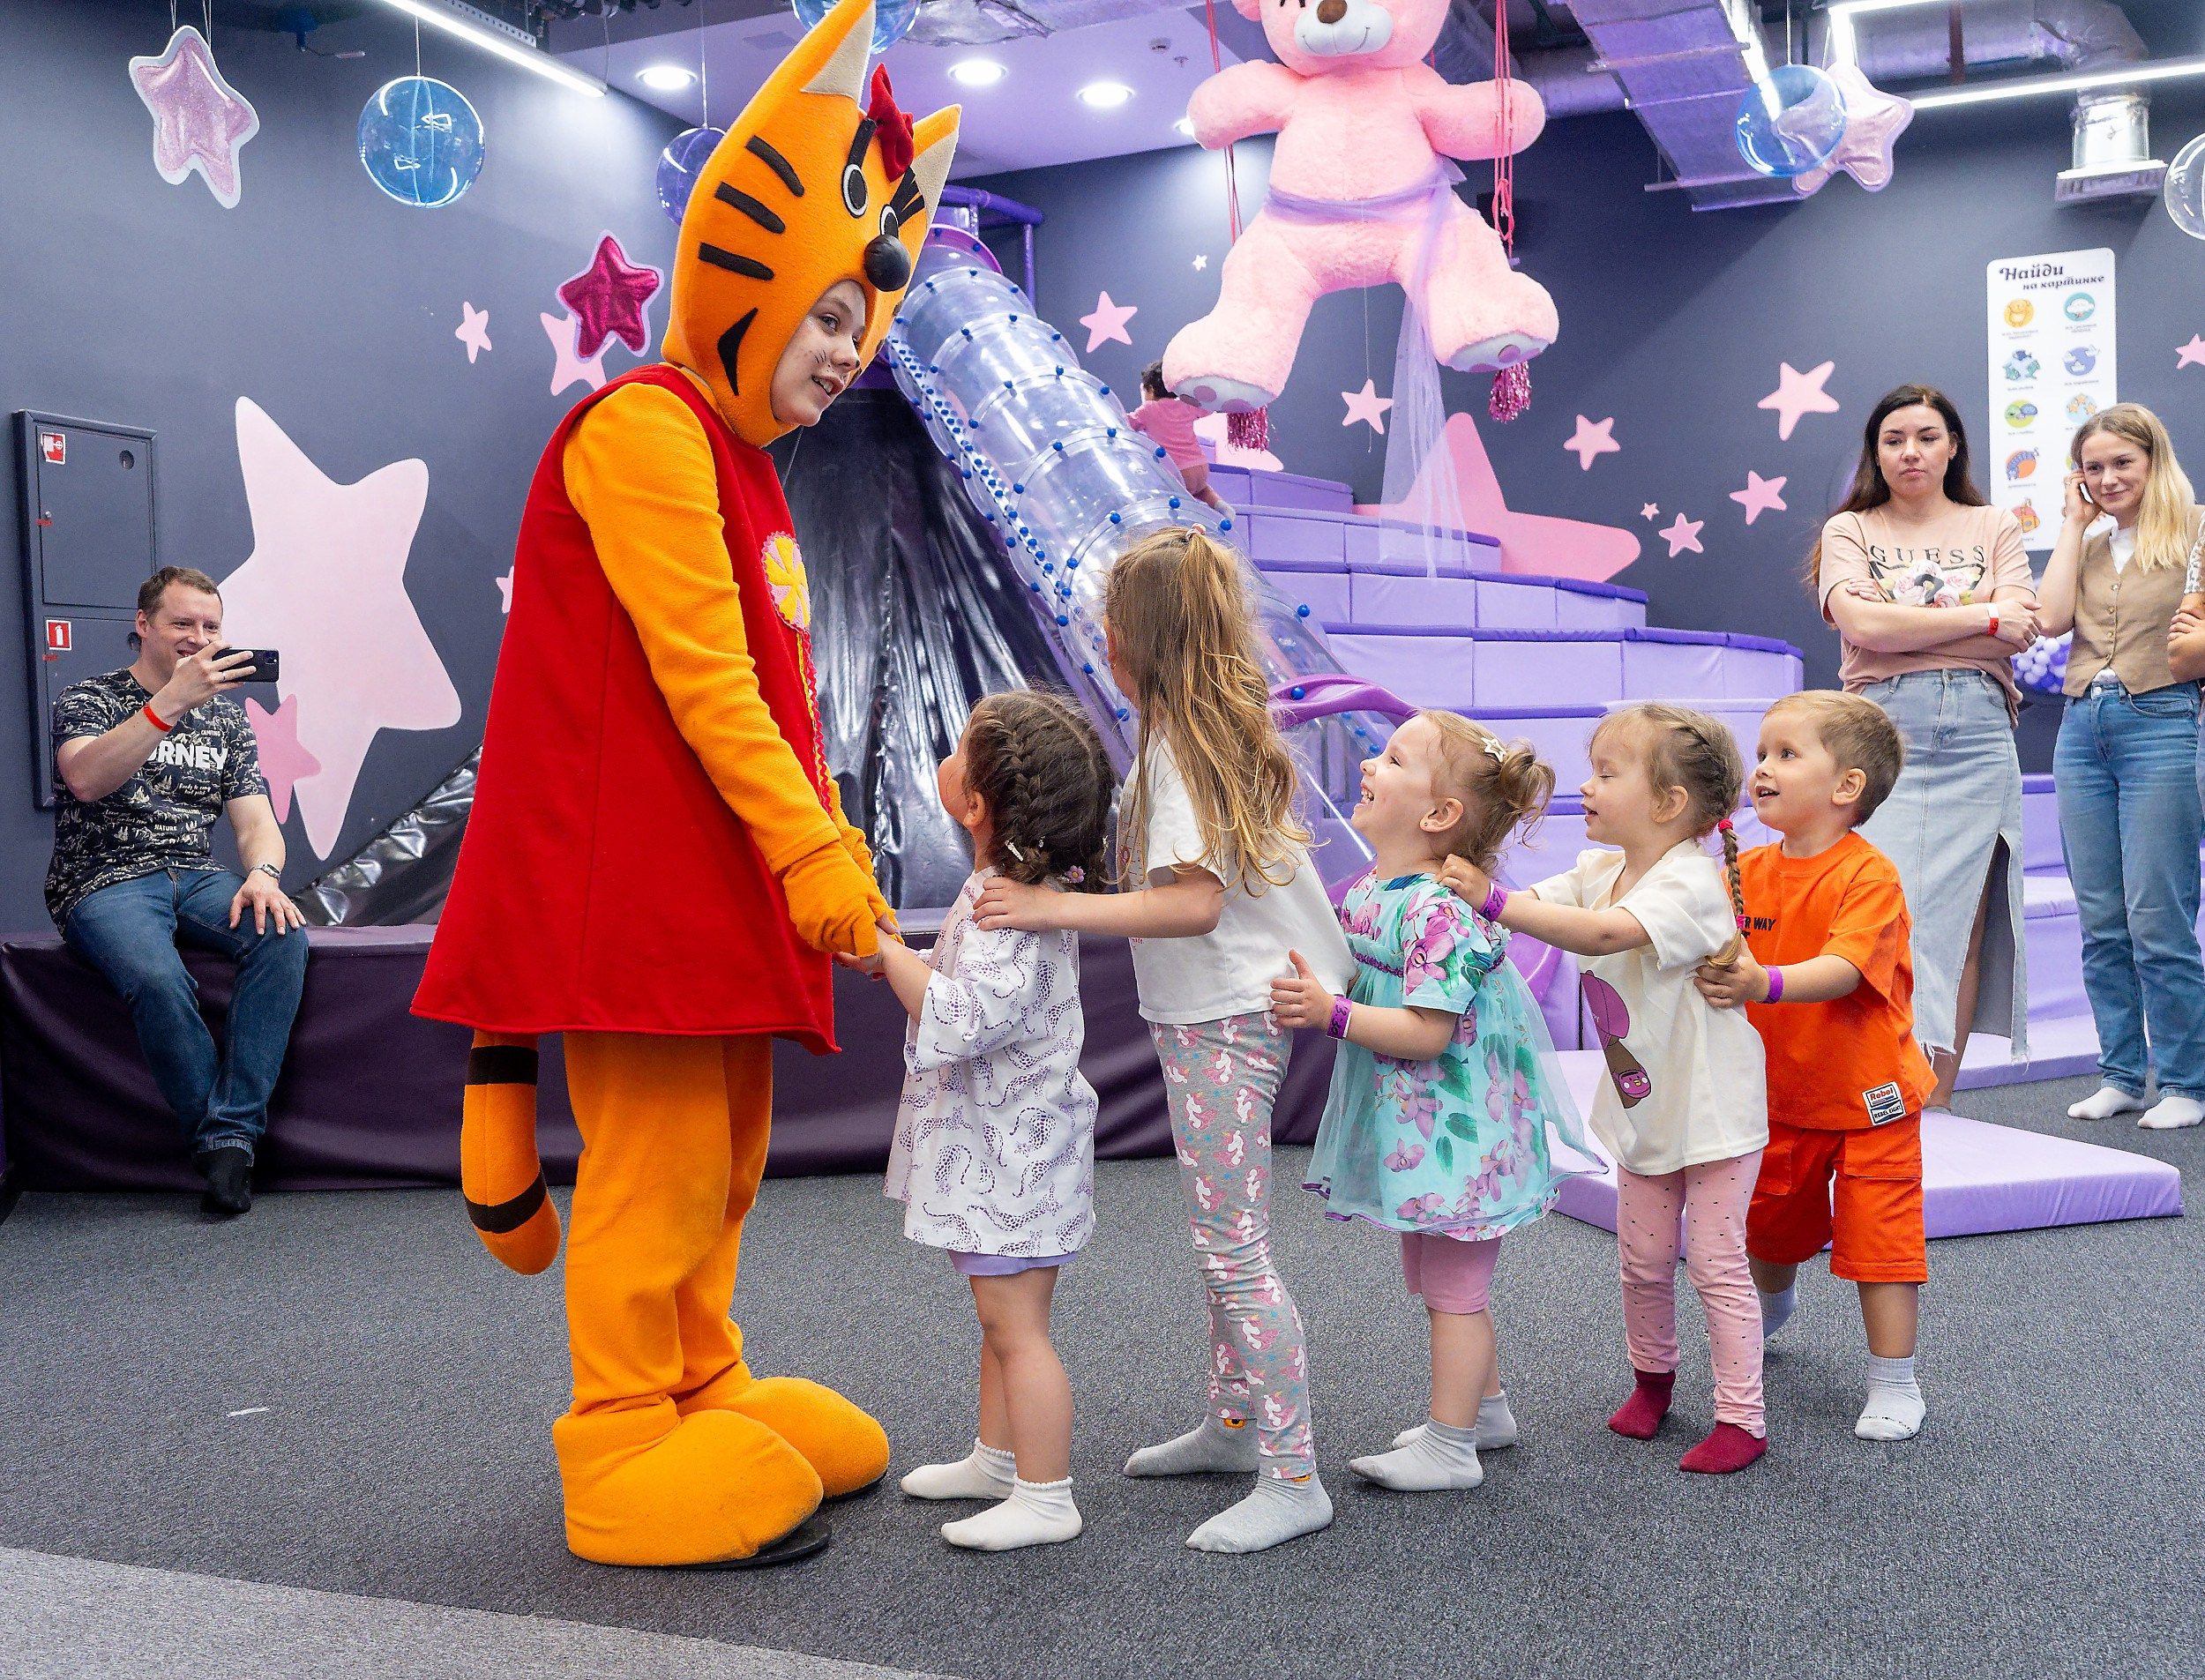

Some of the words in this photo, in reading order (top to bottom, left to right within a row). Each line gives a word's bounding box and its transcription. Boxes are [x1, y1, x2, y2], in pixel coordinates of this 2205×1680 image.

[1999, 264, 2064, 280] Найди
[2040, 275, 2104, 289] картинке
[1869, 545, 1985, 564] GUESS
[1753, 917, 1777, 931] WAY
[1870, 1087, 1894, 1101] Rebel
[1874, 1109, 1888, 1118] REBEL
[1888, 1105, 1902, 1114] EIGHT
